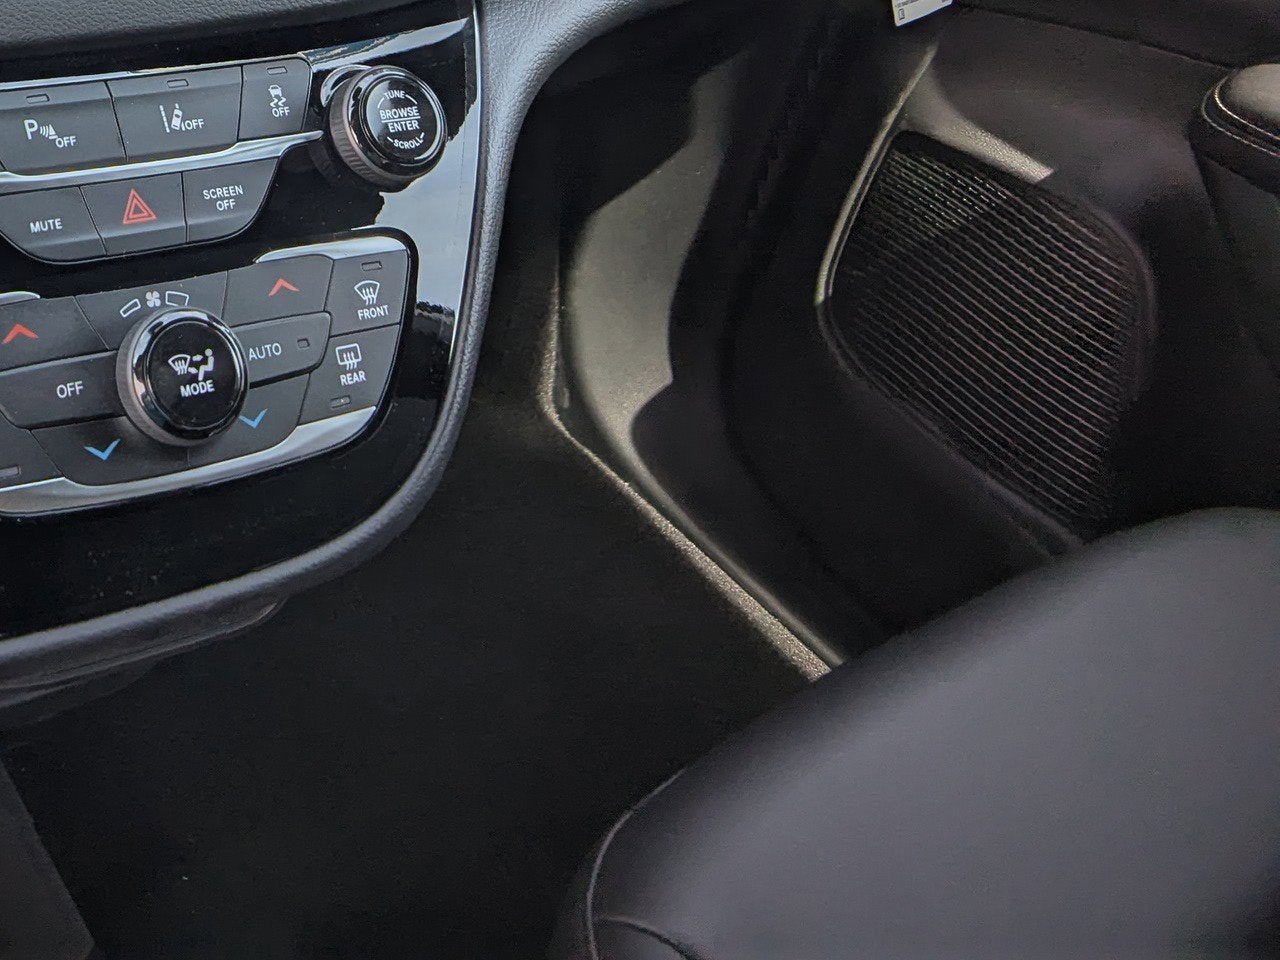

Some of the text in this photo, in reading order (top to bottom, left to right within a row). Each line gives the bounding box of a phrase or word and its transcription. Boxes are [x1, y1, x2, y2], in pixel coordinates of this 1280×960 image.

[384, 89, 406, 100] TUNE
[271, 106, 290, 119] OFF
[379, 106, 420, 120] BROWSE
[184, 117, 205, 131] OFF
[388, 120, 420, 133] ENTER
[55, 135, 77, 149] OFF
[393, 136, 424, 150] SCROLL
[202, 184, 244, 200] SCREEN
[215, 198, 236, 212] OFF
[29, 217, 63, 233] MUTE
[357, 305, 389, 321] FRONT
[248, 343, 283, 360] AUTO
[339, 370, 367, 387] REAR
[56, 380, 84, 399] OFF
[180, 380, 216, 398] MODE
